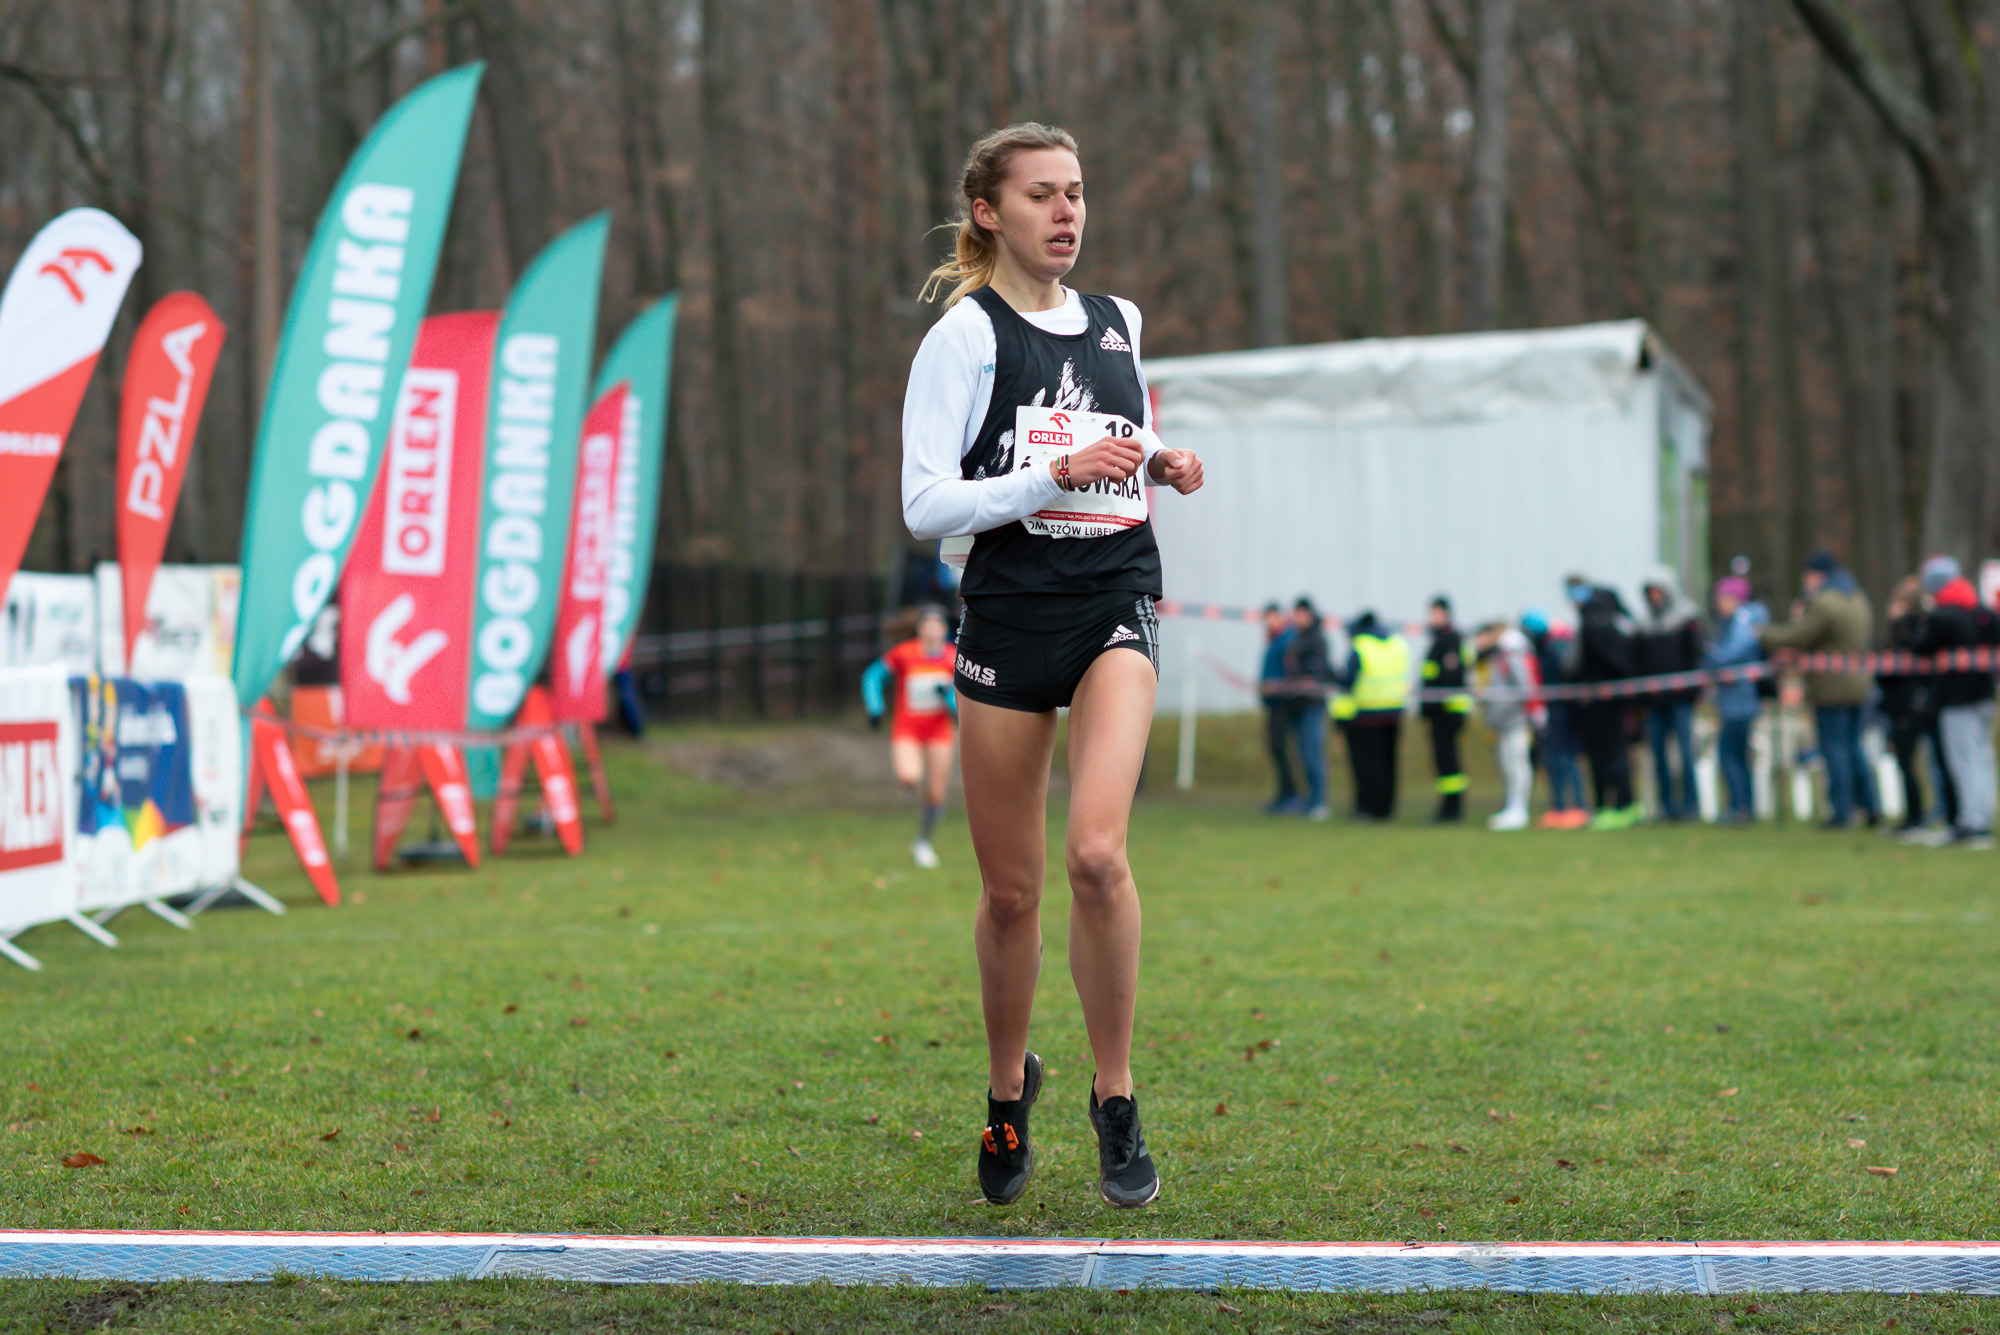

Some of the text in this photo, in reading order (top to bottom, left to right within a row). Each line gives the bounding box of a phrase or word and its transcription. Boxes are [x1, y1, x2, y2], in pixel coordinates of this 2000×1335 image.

[1100, 339, 1131, 352] adidas
[127, 321, 207, 521] PZLA
[1031, 432, 1071, 445] ORLEN
[398, 386, 441, 557] ORLEN
[473, 332, 559, 716] BOGDANKA
[1103, 632, 1140, 648] adidas
[957, 653, 996, 681] SMS
